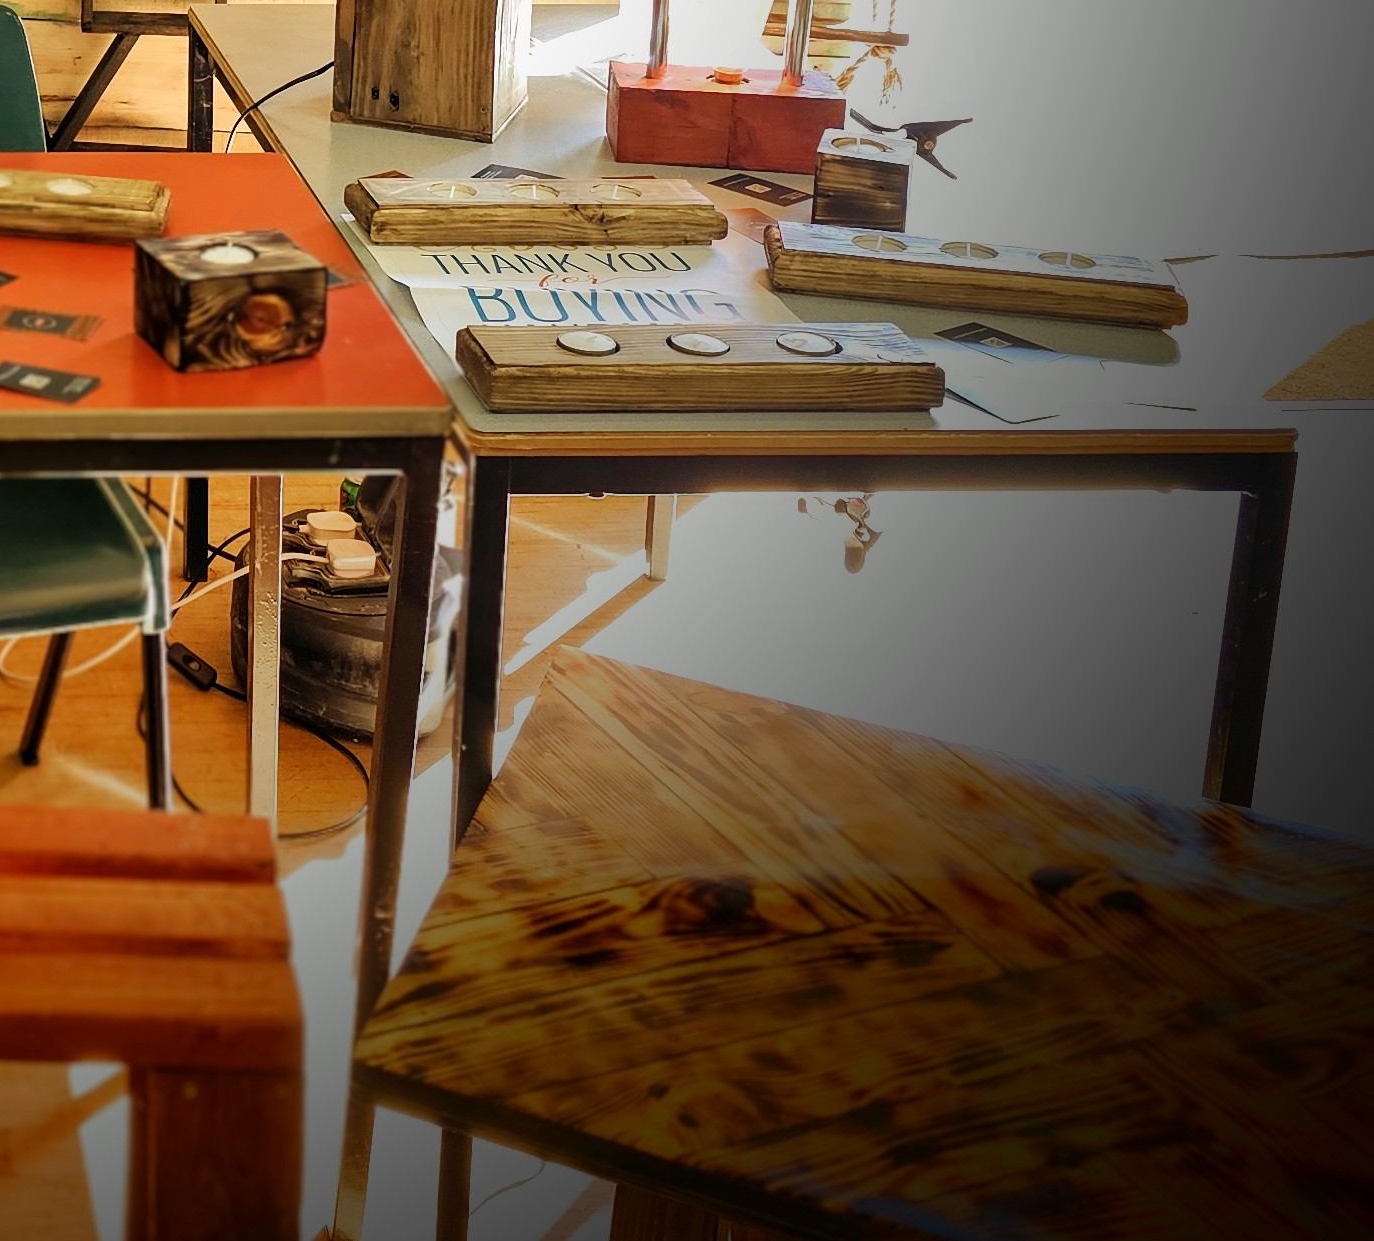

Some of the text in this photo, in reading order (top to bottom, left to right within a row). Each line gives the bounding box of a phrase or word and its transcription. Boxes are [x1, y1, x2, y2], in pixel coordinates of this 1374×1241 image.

[421, 251, 692, 275] THANK YOU
[538, 273, 599, 288] for
[463, 285, 745, 324] BUYING
